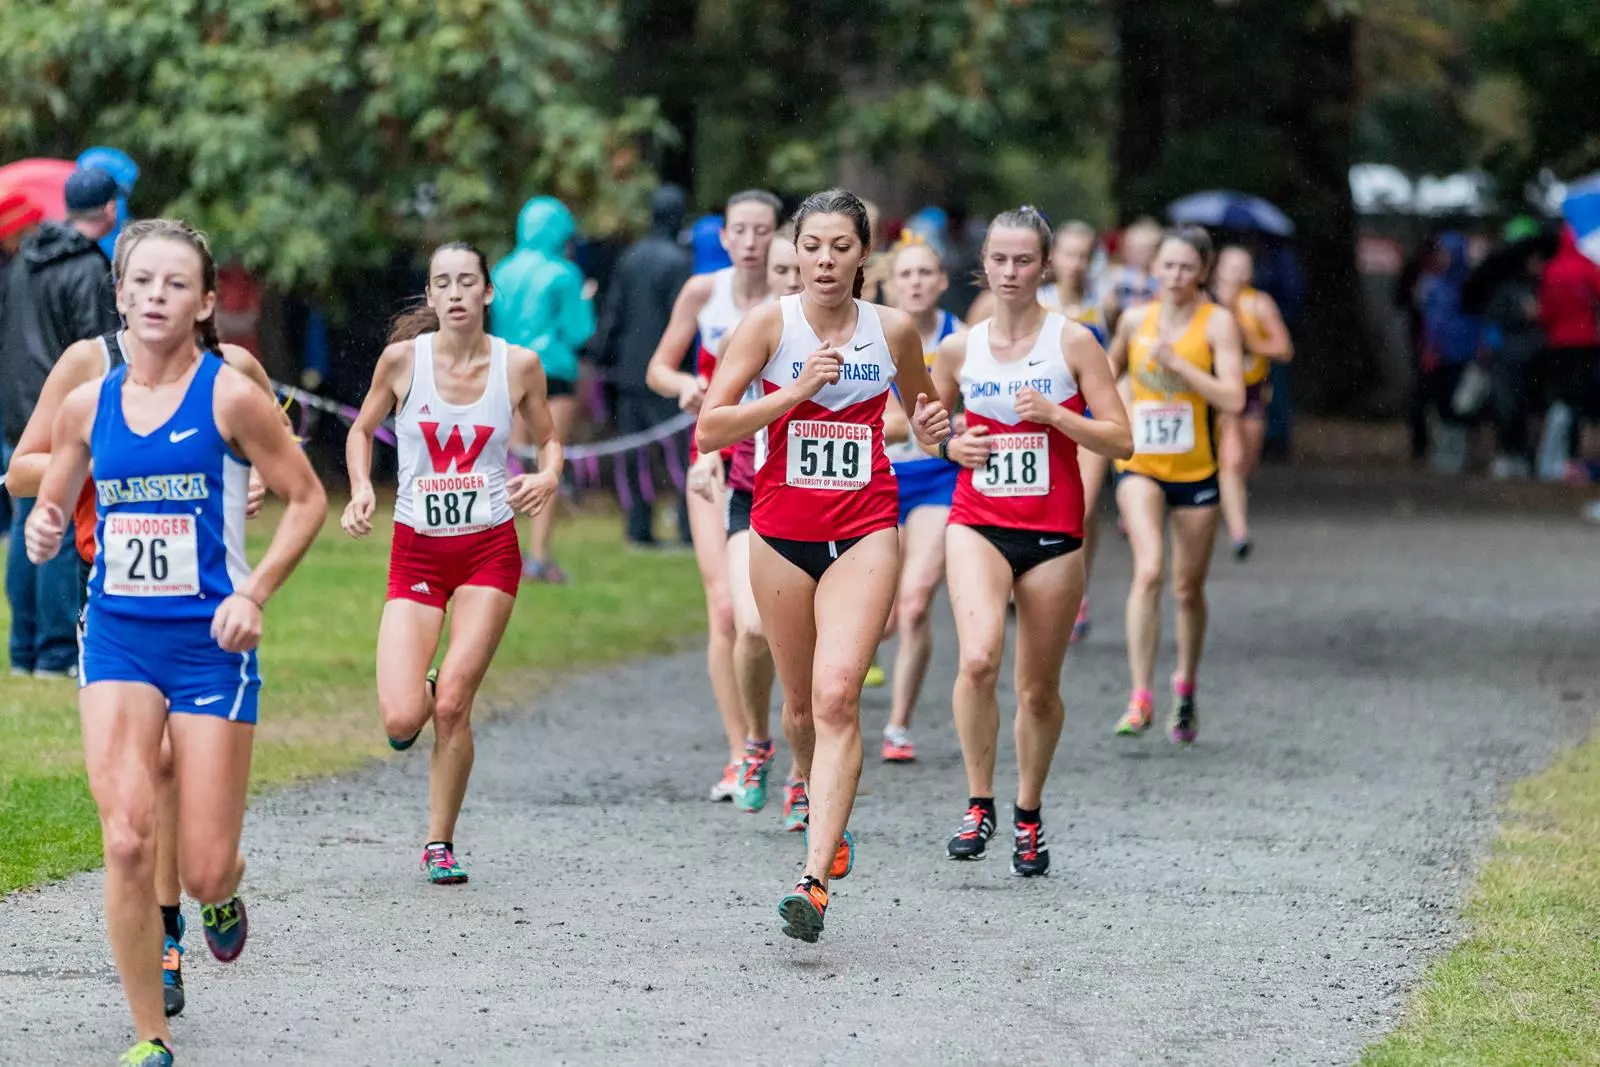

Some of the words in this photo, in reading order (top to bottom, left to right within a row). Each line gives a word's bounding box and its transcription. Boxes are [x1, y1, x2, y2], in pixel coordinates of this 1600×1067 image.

[840, 363, 880, 382] RASER
[970, 382, 1000, 399] SIMON
[794, 422, 868, 440] SUNDODGER
[1144, 416, 1183, 445] 157
[418, 421, 496, 474] W
[800, 438, 860, 479] 519
[985, 451, 1037, 486] 518
[417, 475, 485, 493] SUNDODGER
[793, 477, 822, 486] UNIVERSITY
[823, 479, 831, 487] OF
[832, 480, 867, 488] WASHINGTON
[425, 491, 478, 527] 687
[111, 517, 190, 536] SUNDODGER
[126, 538, 169, 580] 26
